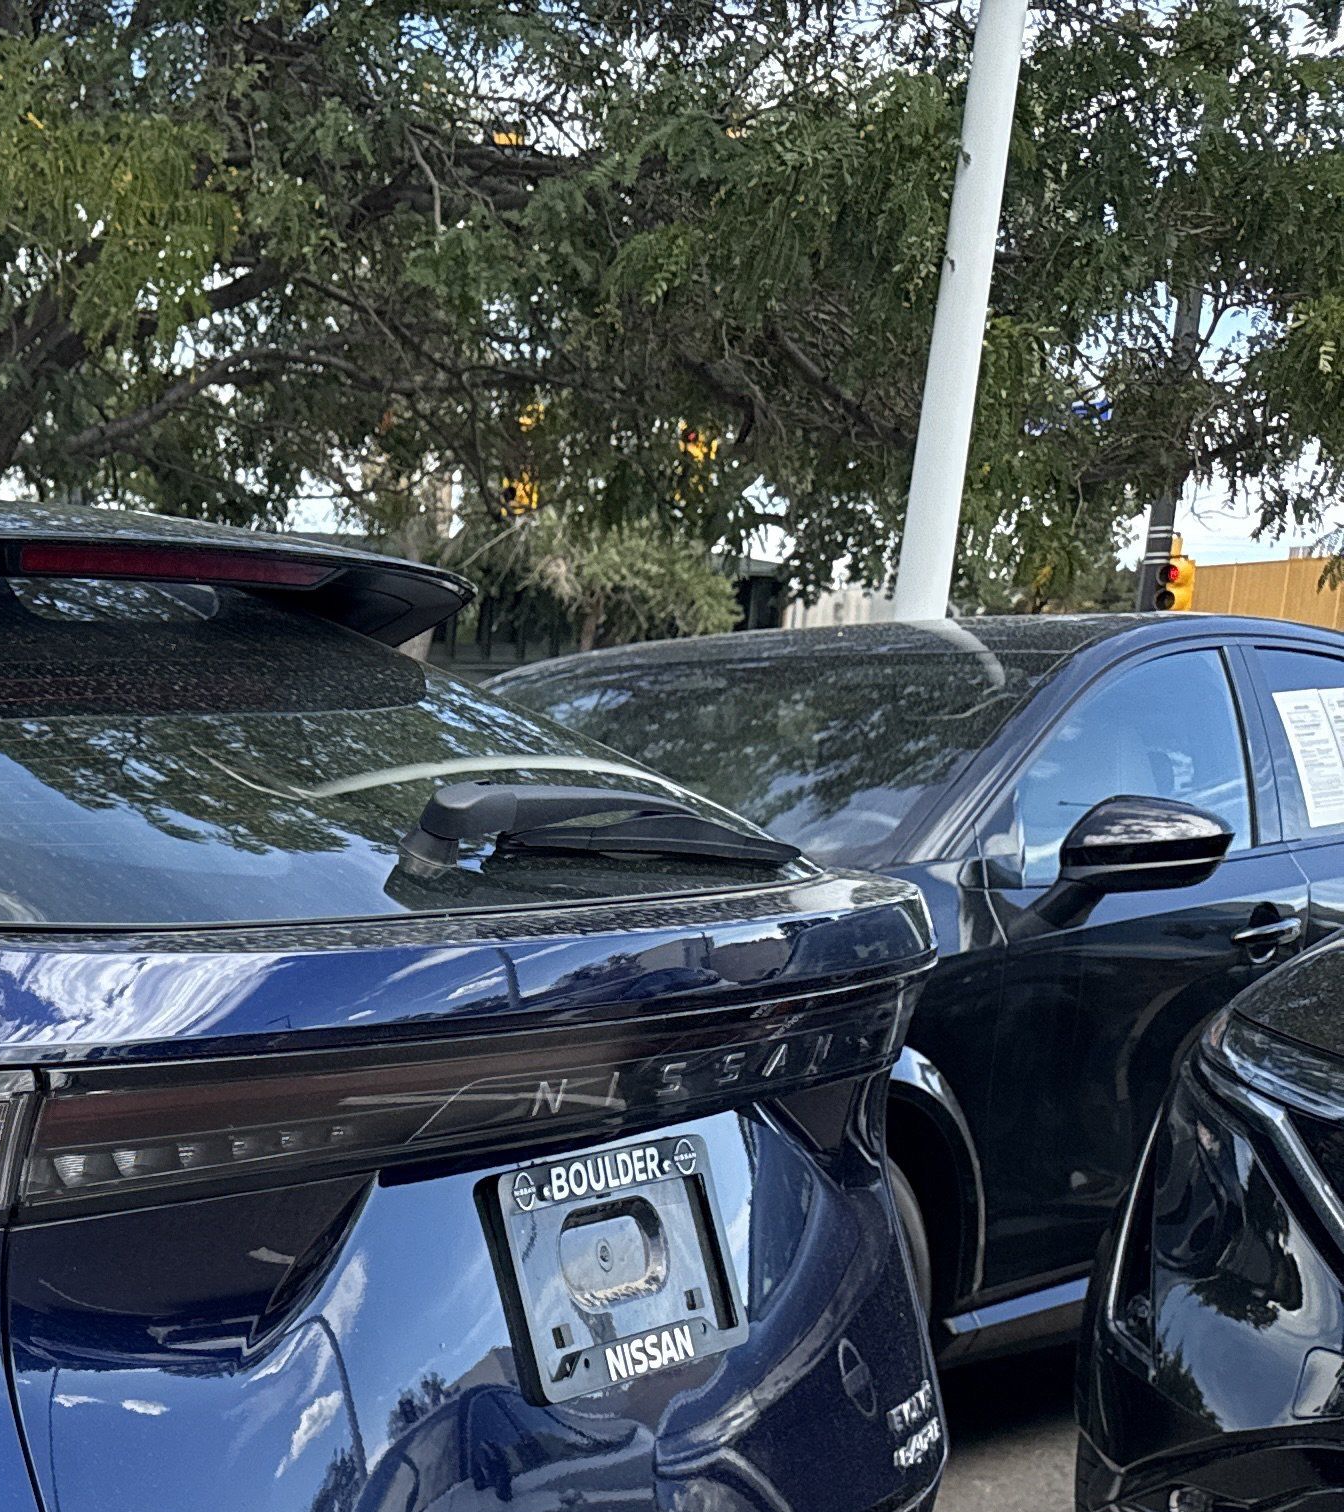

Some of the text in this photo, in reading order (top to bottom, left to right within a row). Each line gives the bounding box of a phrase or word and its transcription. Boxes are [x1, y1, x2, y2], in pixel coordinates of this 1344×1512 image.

[530, 1032, 835, 1118] NISSAN
[550, 1146, 662, 1201] BOULDER
[604, 1324, 695, 1382] NISSAN
